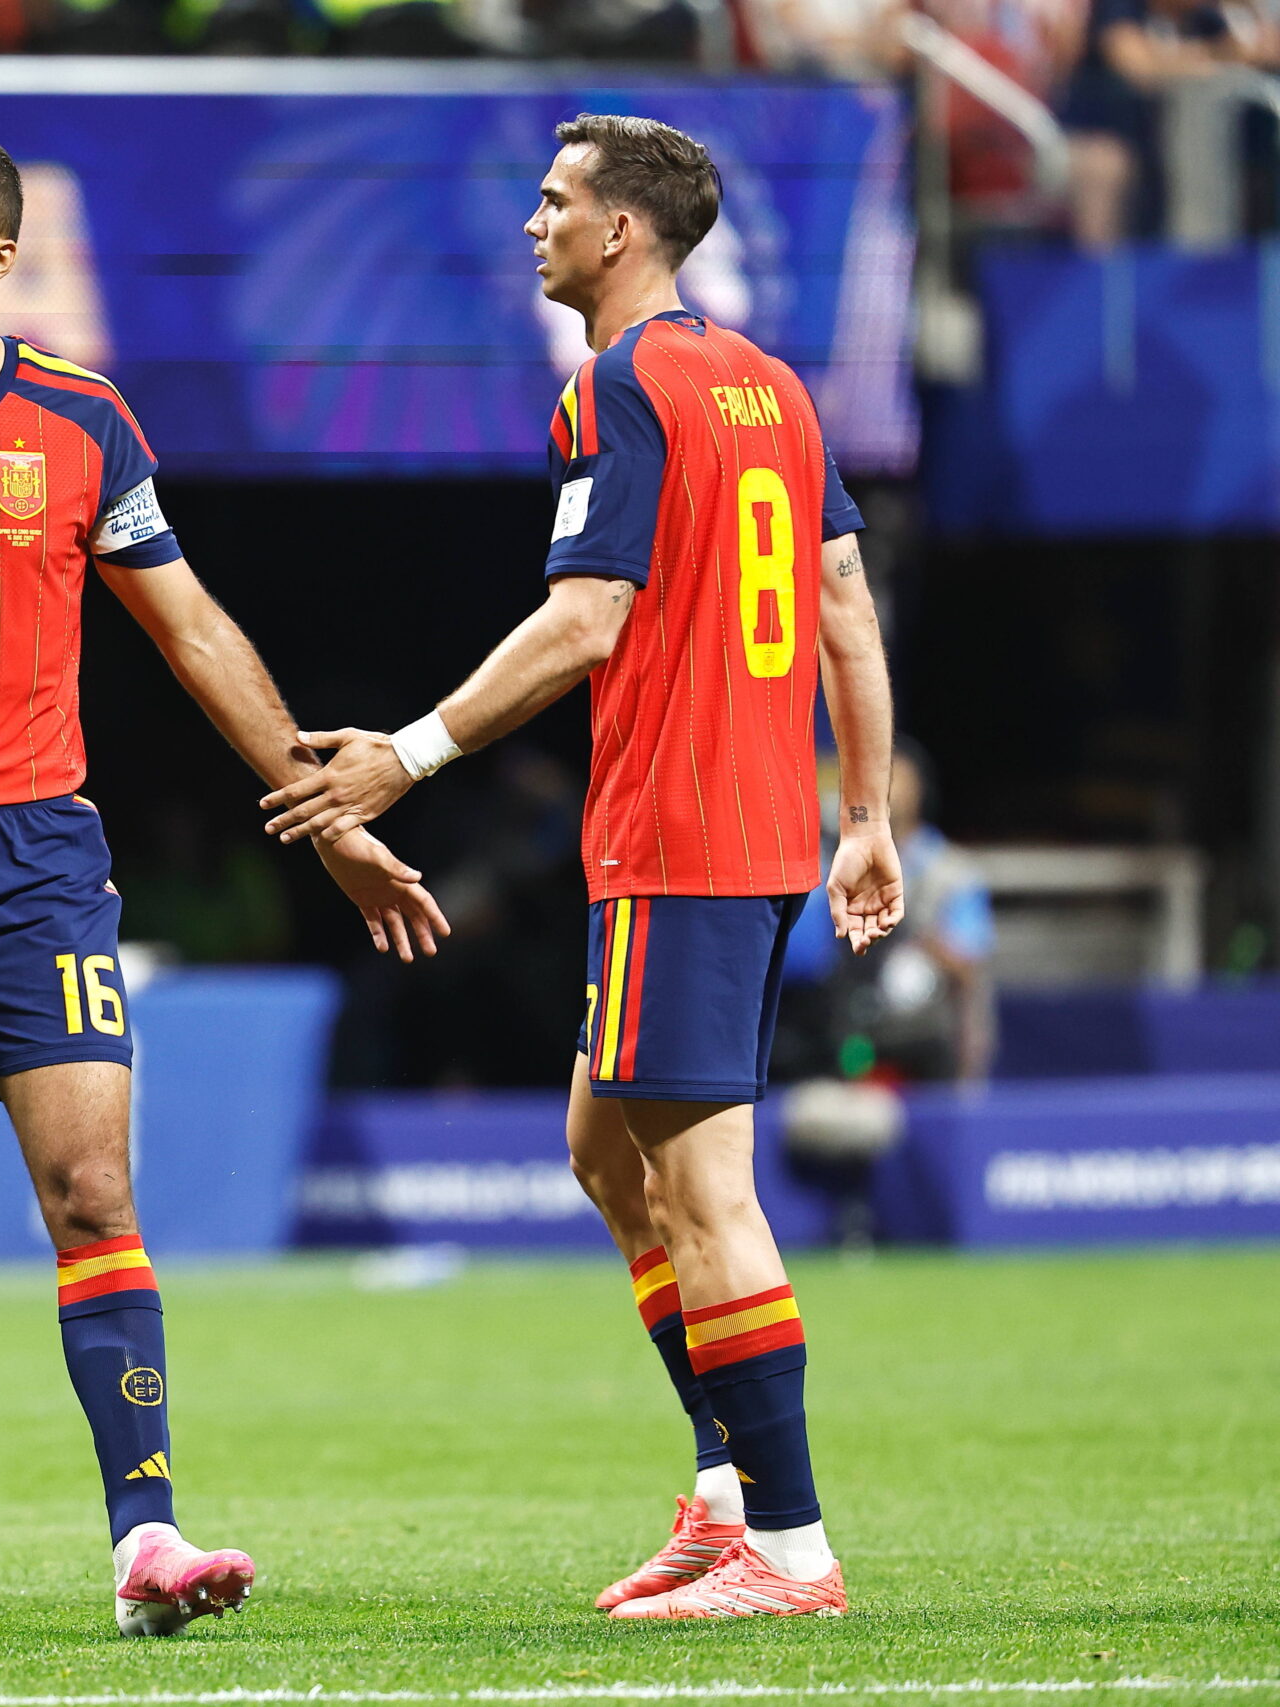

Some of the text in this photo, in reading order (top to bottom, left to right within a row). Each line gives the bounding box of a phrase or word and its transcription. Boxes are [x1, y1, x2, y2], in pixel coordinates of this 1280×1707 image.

[708, 376, 783, 427] FABIÁN
[108, 519, 132, 535] the
[131, 527, 154, 540] FIFA
[738, 467, 795, 679] 8
[55, 953, 125, 1037] 16
